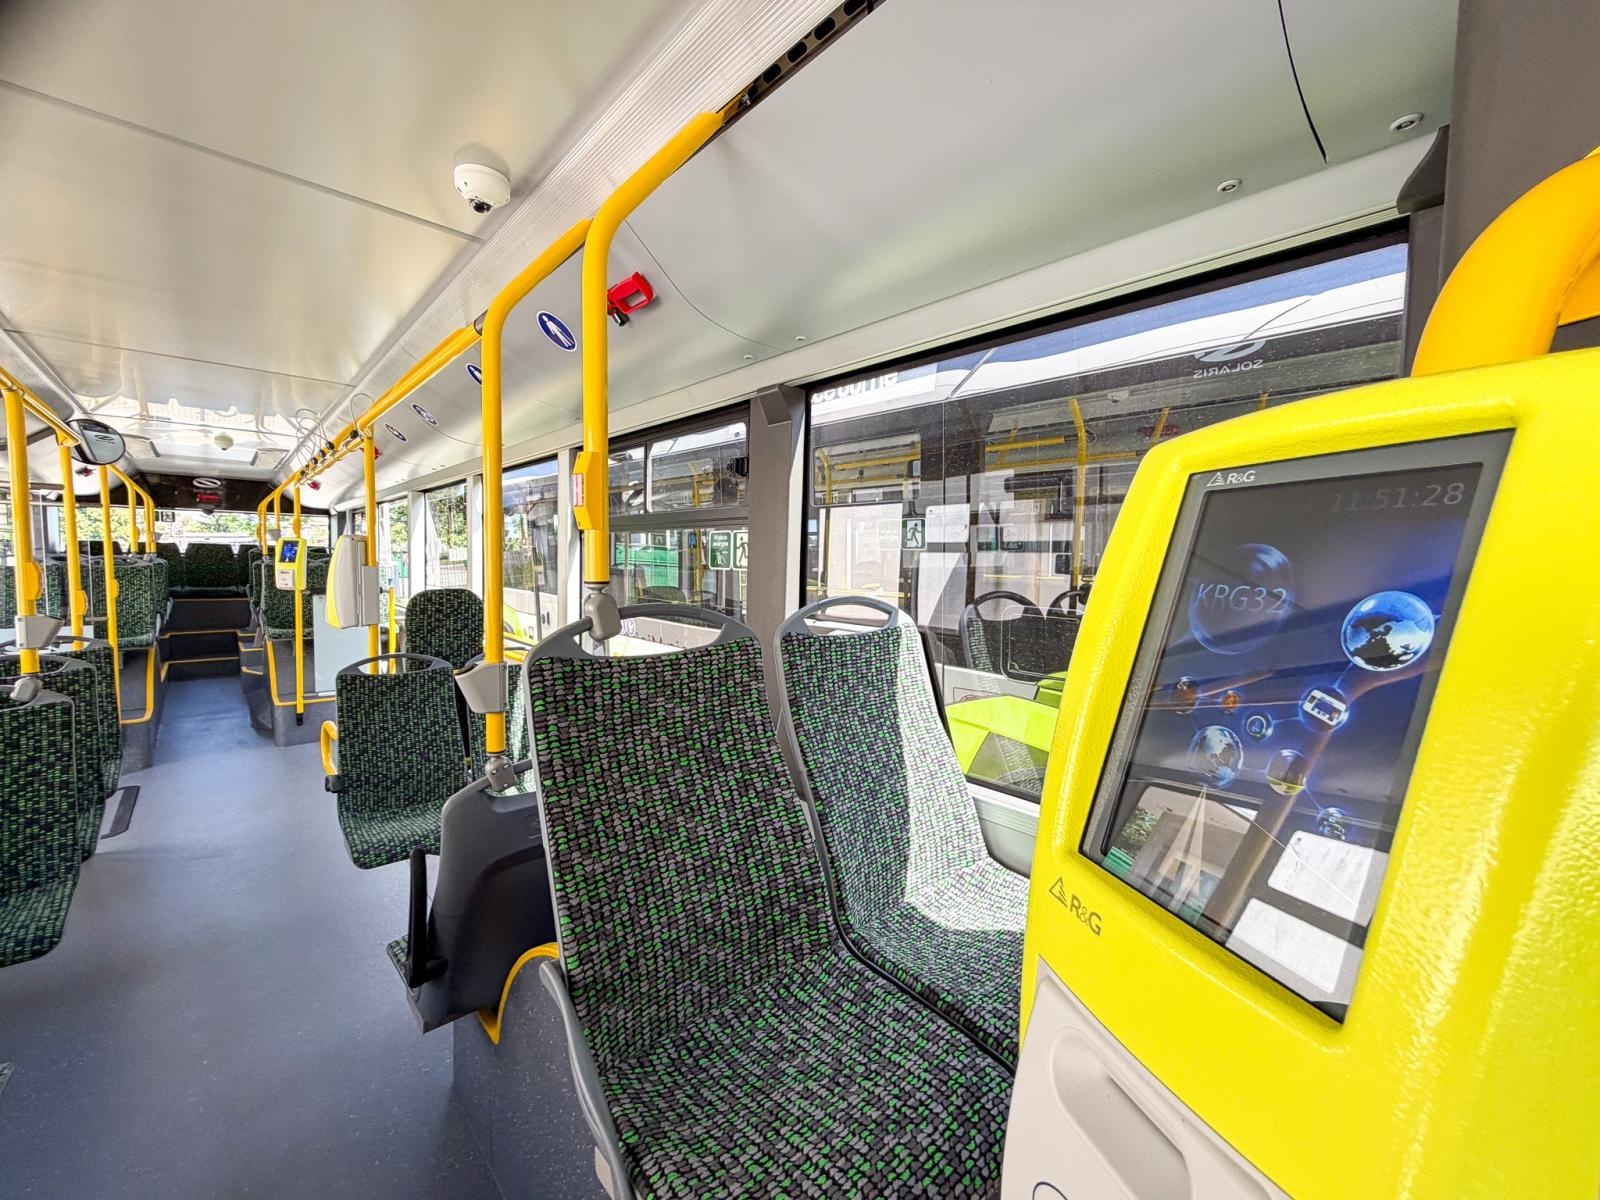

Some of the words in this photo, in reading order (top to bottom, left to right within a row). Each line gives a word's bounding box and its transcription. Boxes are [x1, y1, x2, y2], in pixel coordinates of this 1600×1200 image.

[1226, 469, 1257, 485] R&G
[1194, 583, 1288, 614] KRG32
[1069, 894, 1102, 936] R&G
